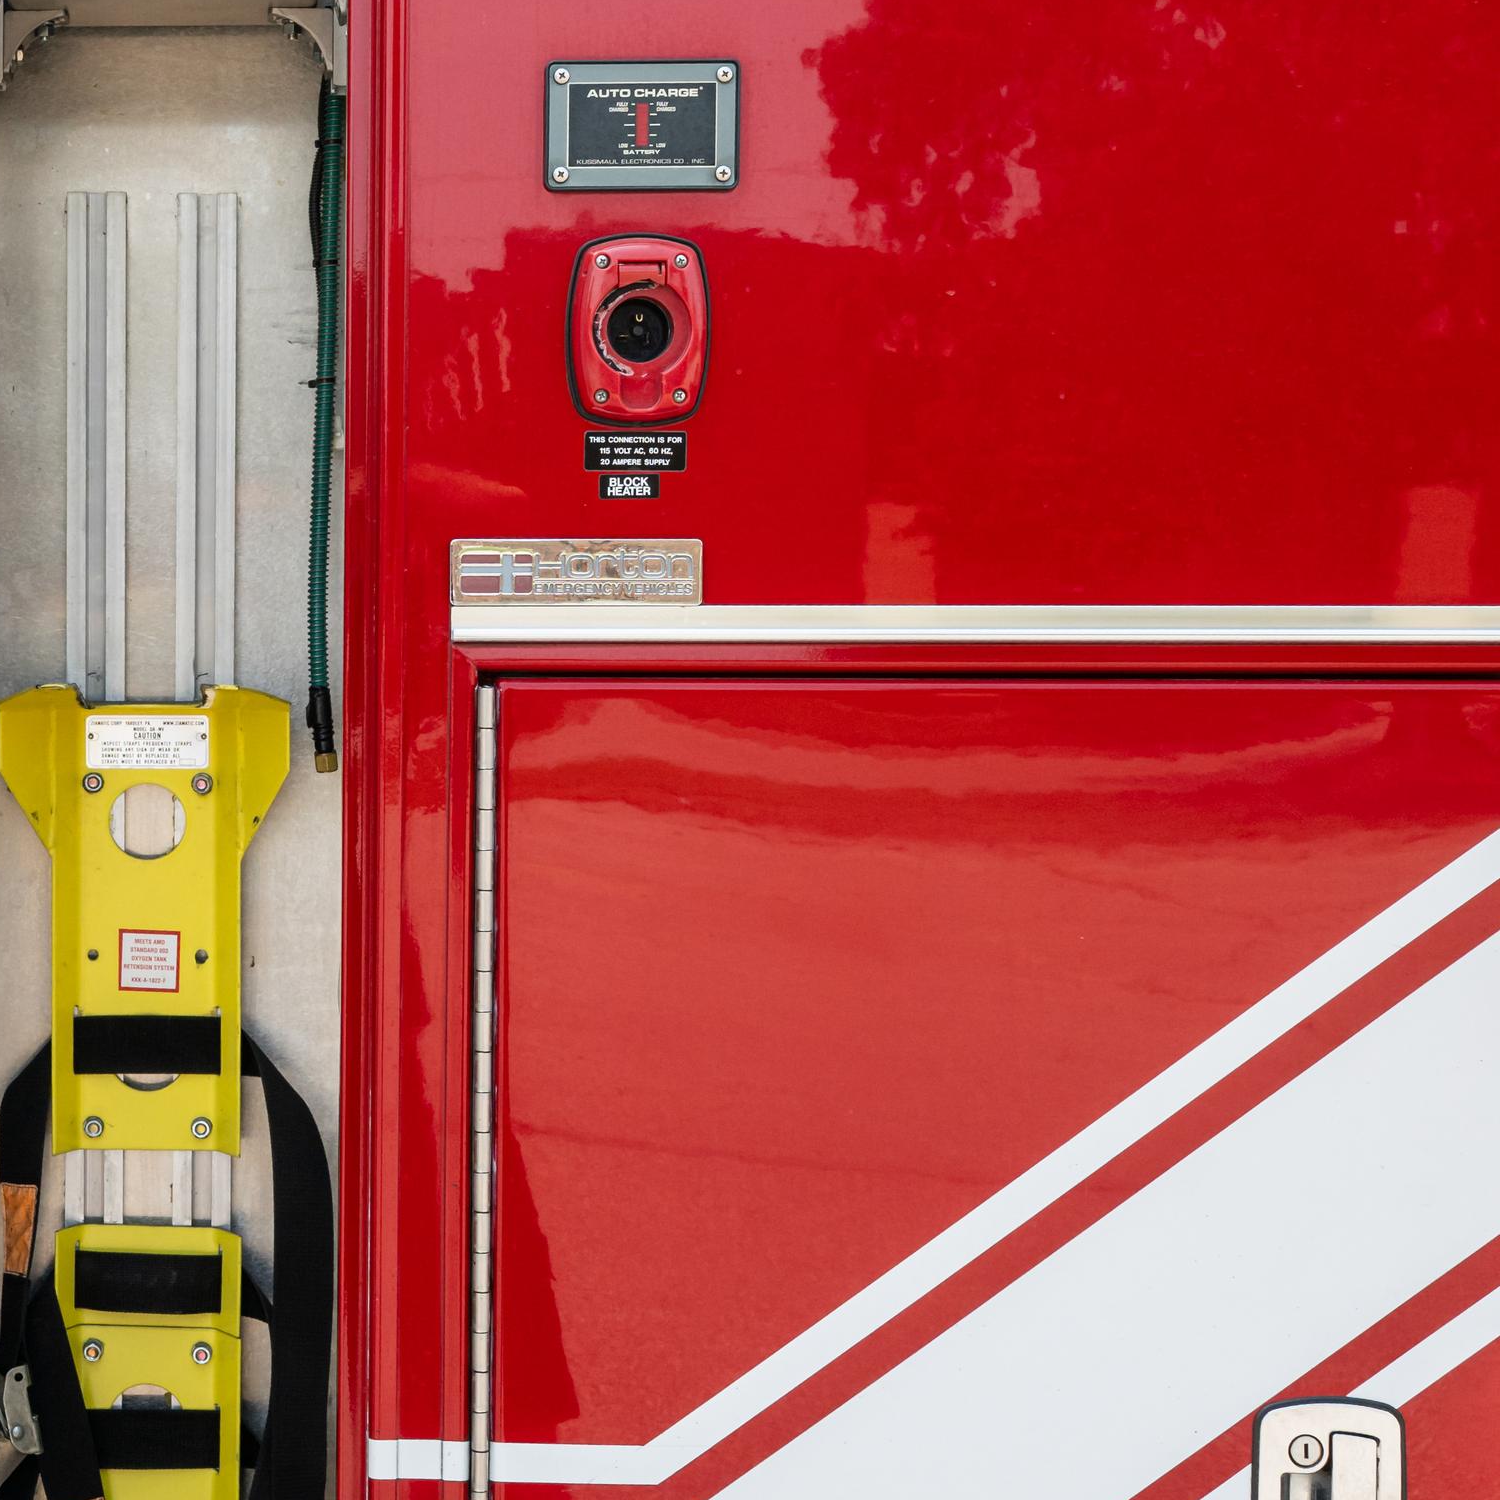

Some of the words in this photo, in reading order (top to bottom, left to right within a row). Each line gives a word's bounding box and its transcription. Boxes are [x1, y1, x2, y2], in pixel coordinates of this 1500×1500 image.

[587, 89, 631, 98] AUTO
[609, 477, 649, 487] BLOCK
[607, 487, 651, 496] HEATER
[533, 549, 694, 579] Horton
[533, 583, 621, 595] EMERGENCY
[623, 583, 693, 595] VEHICLES
